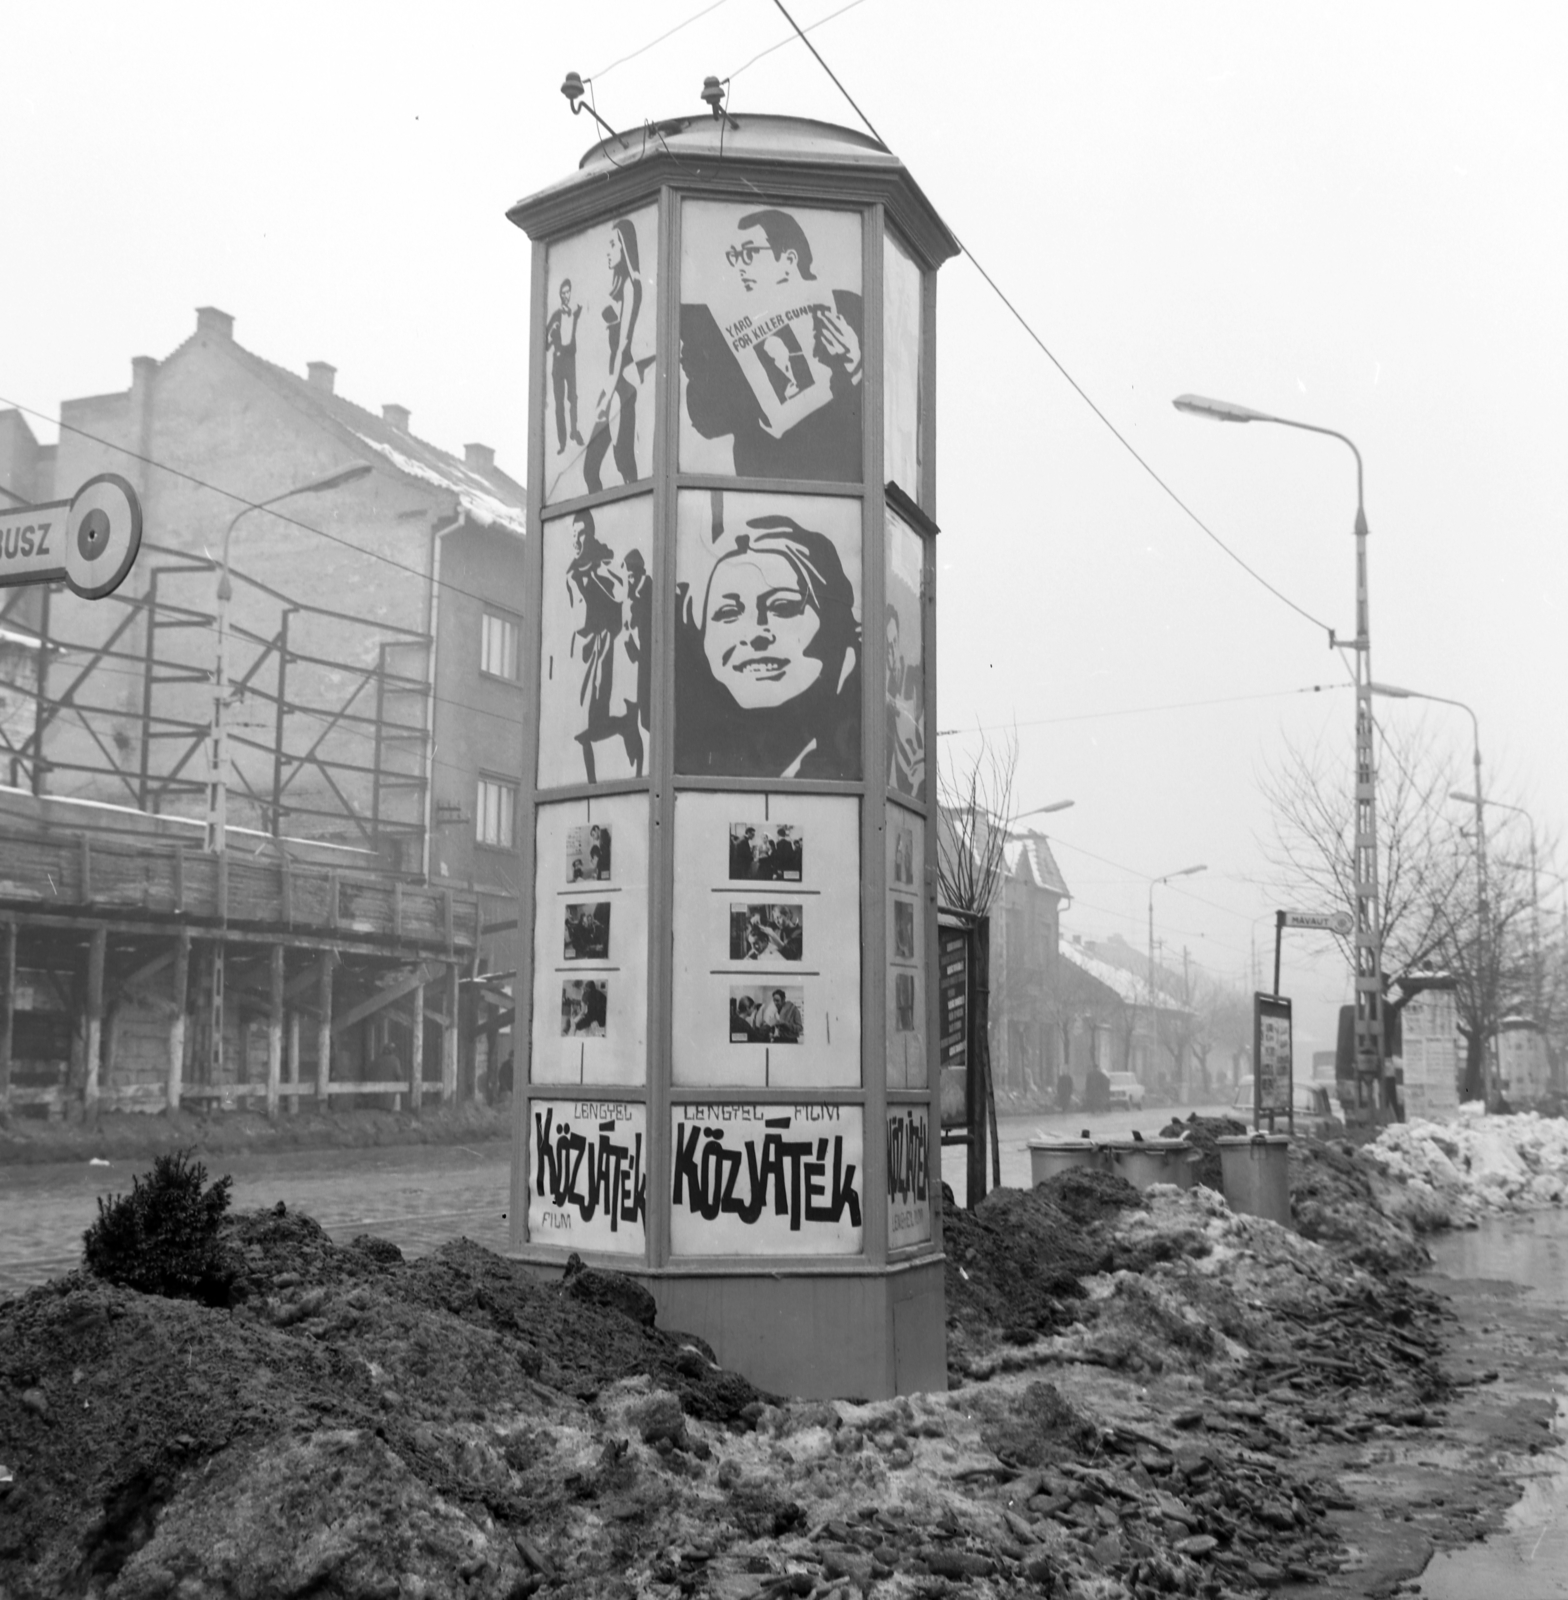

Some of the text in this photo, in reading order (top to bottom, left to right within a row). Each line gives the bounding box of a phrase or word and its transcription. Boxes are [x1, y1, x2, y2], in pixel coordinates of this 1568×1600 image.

[725, 315, 753, 338] YARD
[732, 332, 754, 353] FOR
[751, 314, 785, 341] KILLER
[0, 522, 52, 560] USZ
[574, 1102, 632, 1121] LENGYEL
[684, 1105, 840, 1121] LENGYEL FILM
[535, 1107, 646, 1238] KÖZJÁTÉK
[673, 1117, 862, 1231] KÖZJÁTÉK
[542, 1211, 572, 1230] FILM
